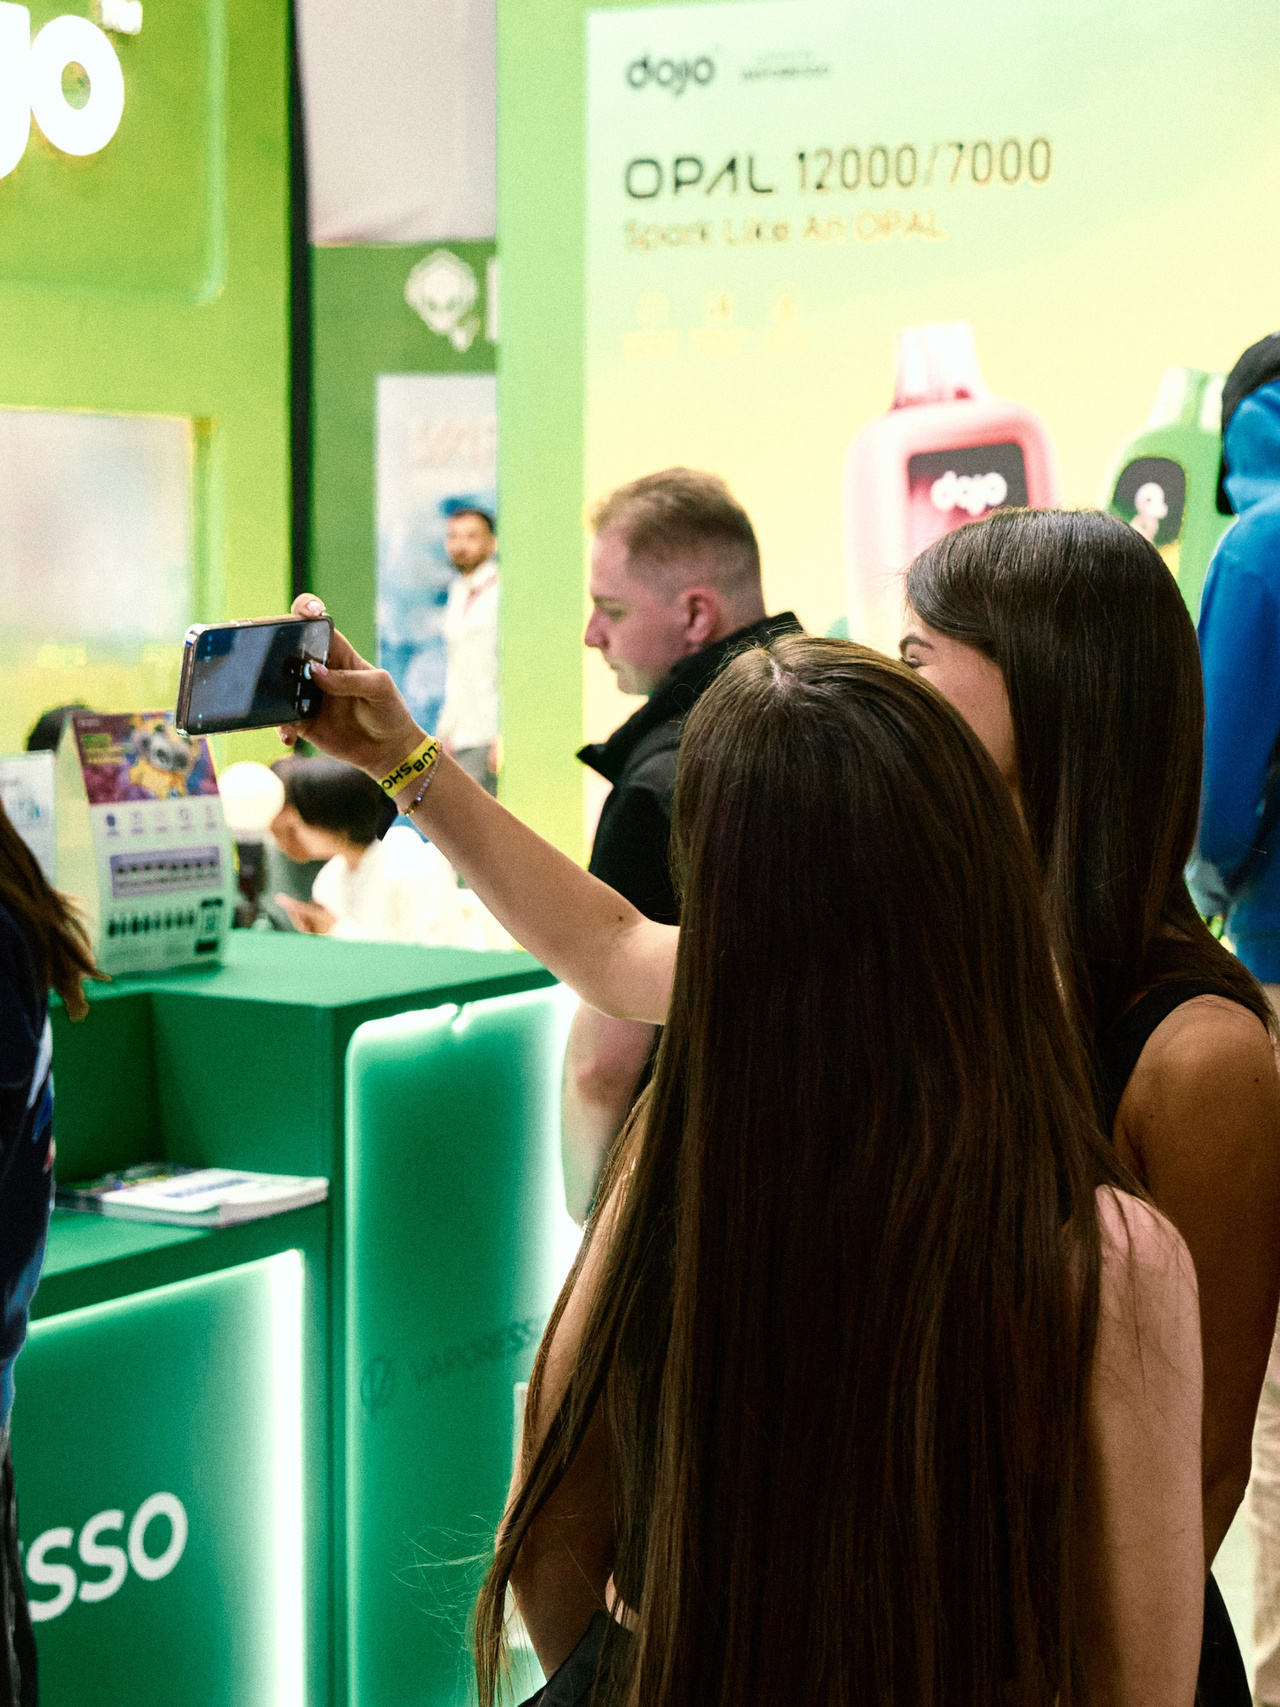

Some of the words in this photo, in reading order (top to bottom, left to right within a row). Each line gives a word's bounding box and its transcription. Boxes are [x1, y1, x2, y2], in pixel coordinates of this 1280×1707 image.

[626, 50, 715, 97] dojo
[625, 154, 774, 200] OPAL
[797, 136, 1053, 192] 12000/7000
[624, 216, 713, 252] Spark
[723, 213, 790, 245] Like
[802, 215, 847, 243] An
[854, 206, 949, 245] OPAL
[930, 470, 1008, 515] dojo
[18, 1491, 189, 1623] SSO
